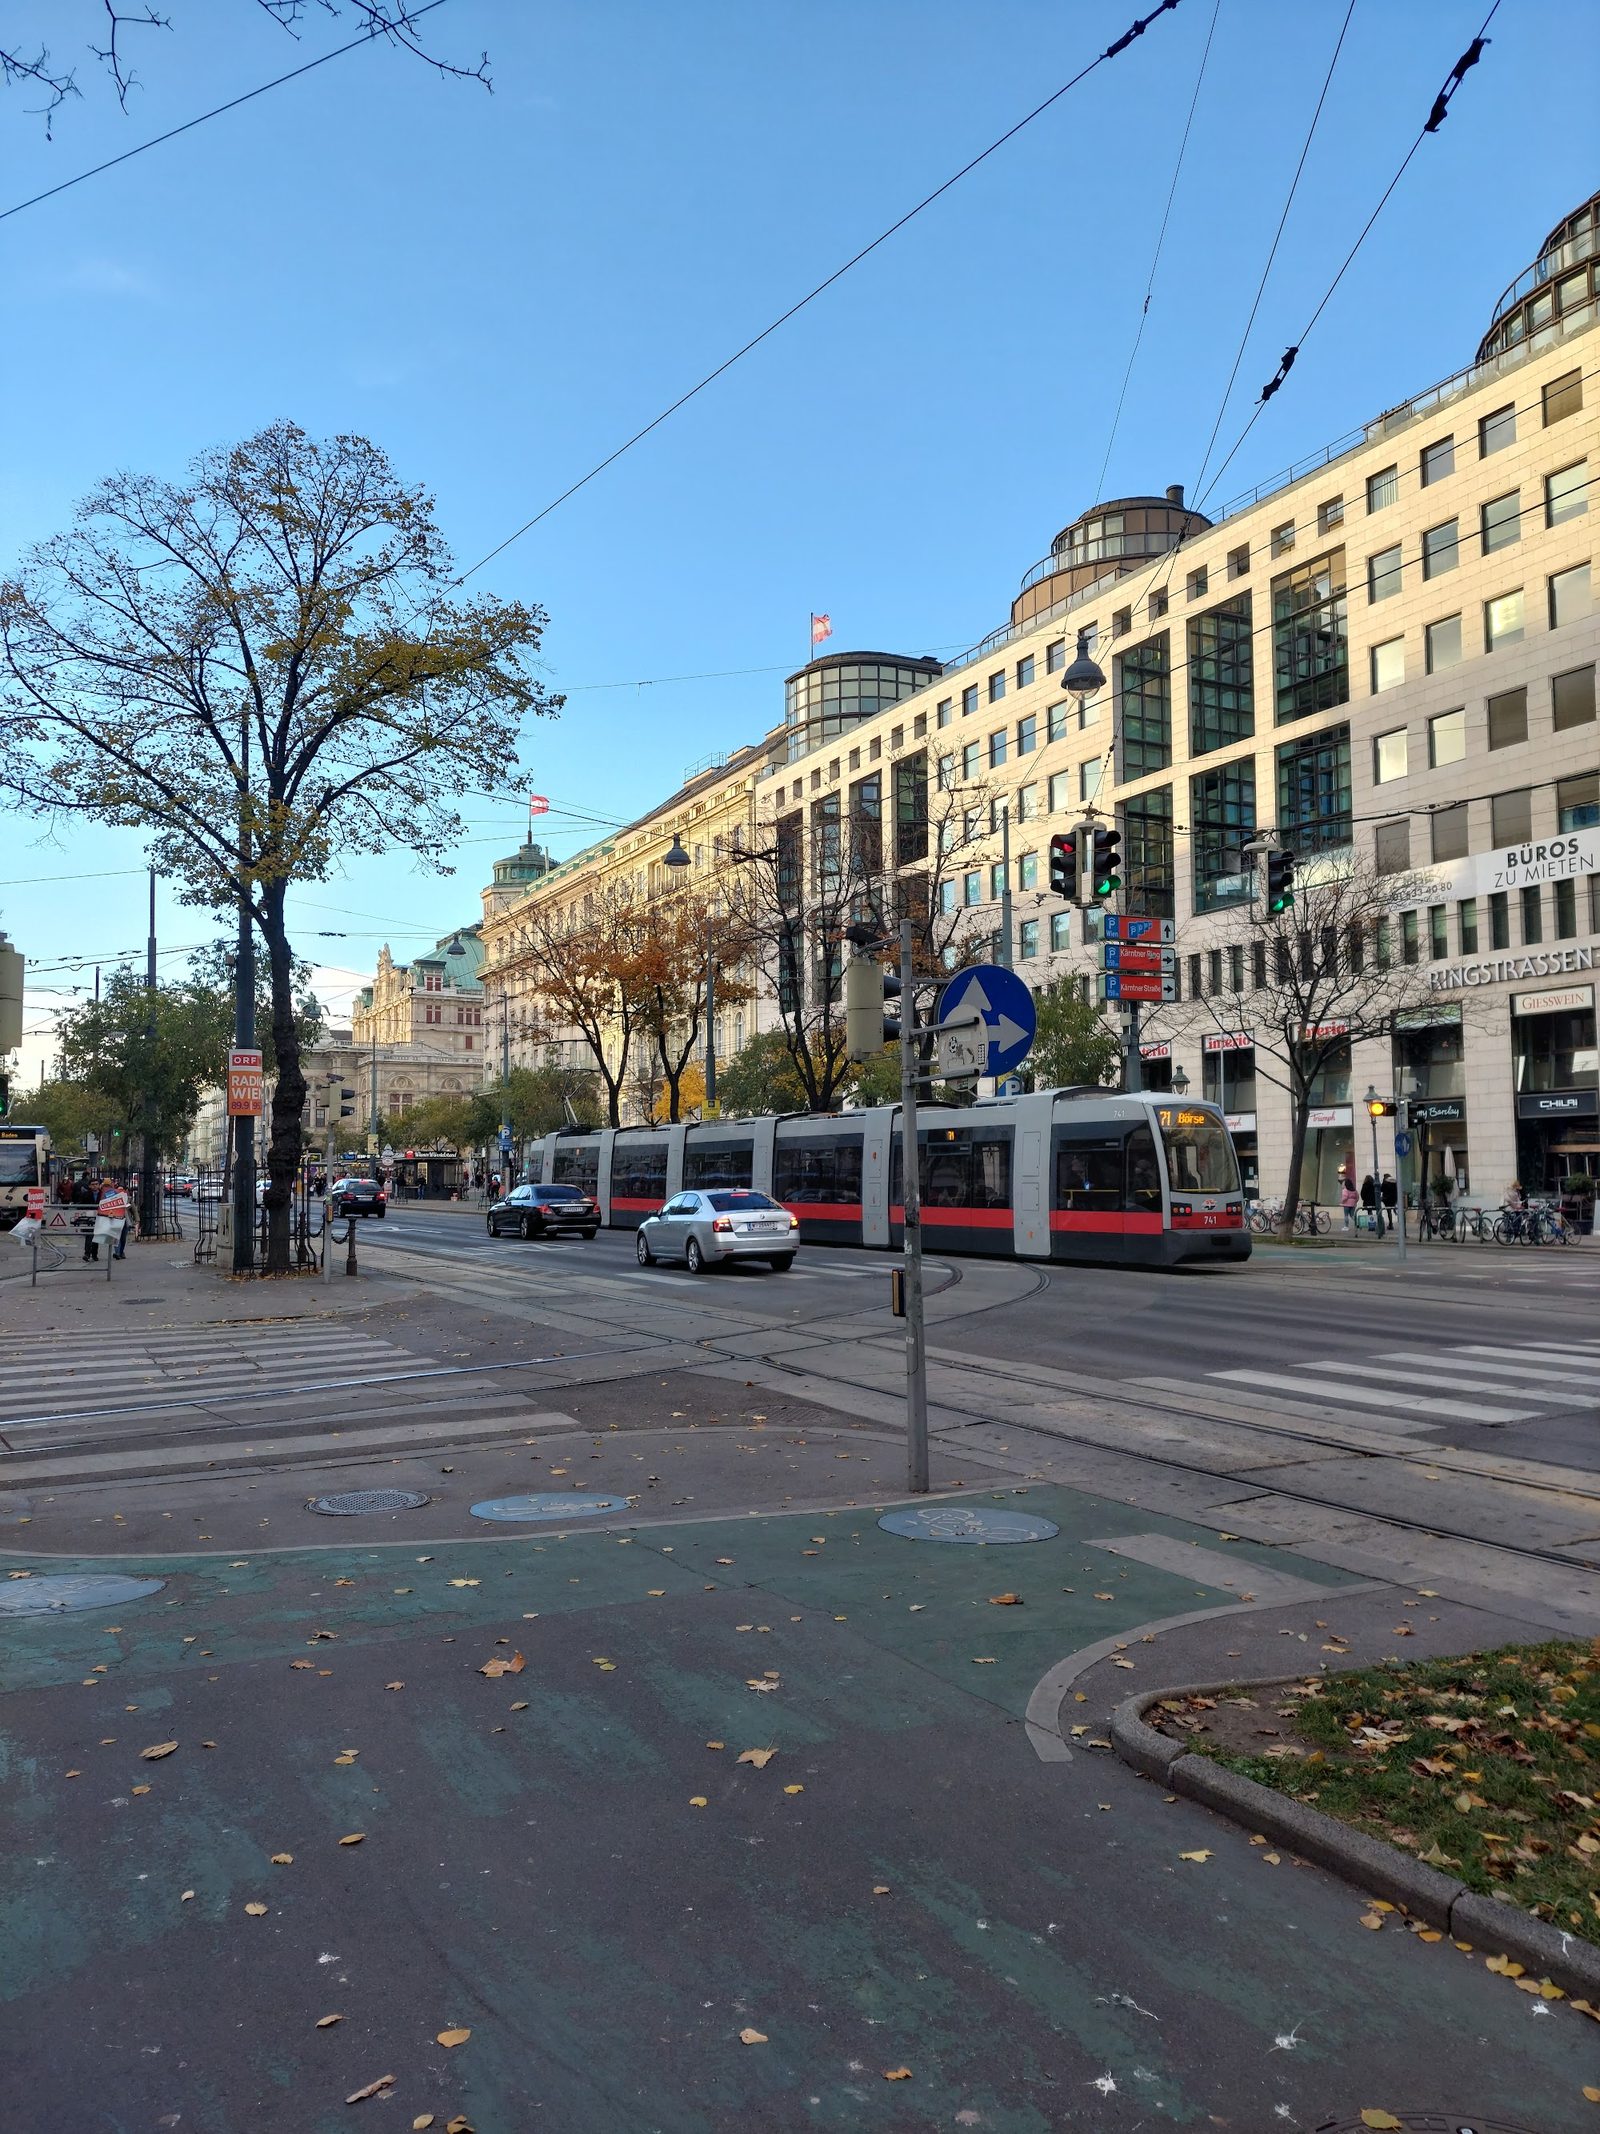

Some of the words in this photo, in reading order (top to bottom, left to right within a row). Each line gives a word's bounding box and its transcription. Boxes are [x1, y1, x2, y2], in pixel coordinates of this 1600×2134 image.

[1507, 838, 1579, 868] BÜROS
[1494, 869, 1516, 888] ZU
[1524, 853, 1594, 882] MIETEN
[1440, 881, 1453, 892] 80
[1120, 949, 1146, 957] Kärntner
[1120, 983, 1143, 992] Kärntner
[1144, 984, 1161, 993] Straße
[1522, 992, 1585, 1010] GIESSWEIN
[233, 1056, 257, 1064] ORF
[231, 1087, 262, 1100] WIE
[1113, 1110, 1125, 1118] 741
[1160, 1111, 1171, 1126] 71
[1177, 1112, 1205, 1125] Börse
[1203, 1215, 1217, 1225] 741
